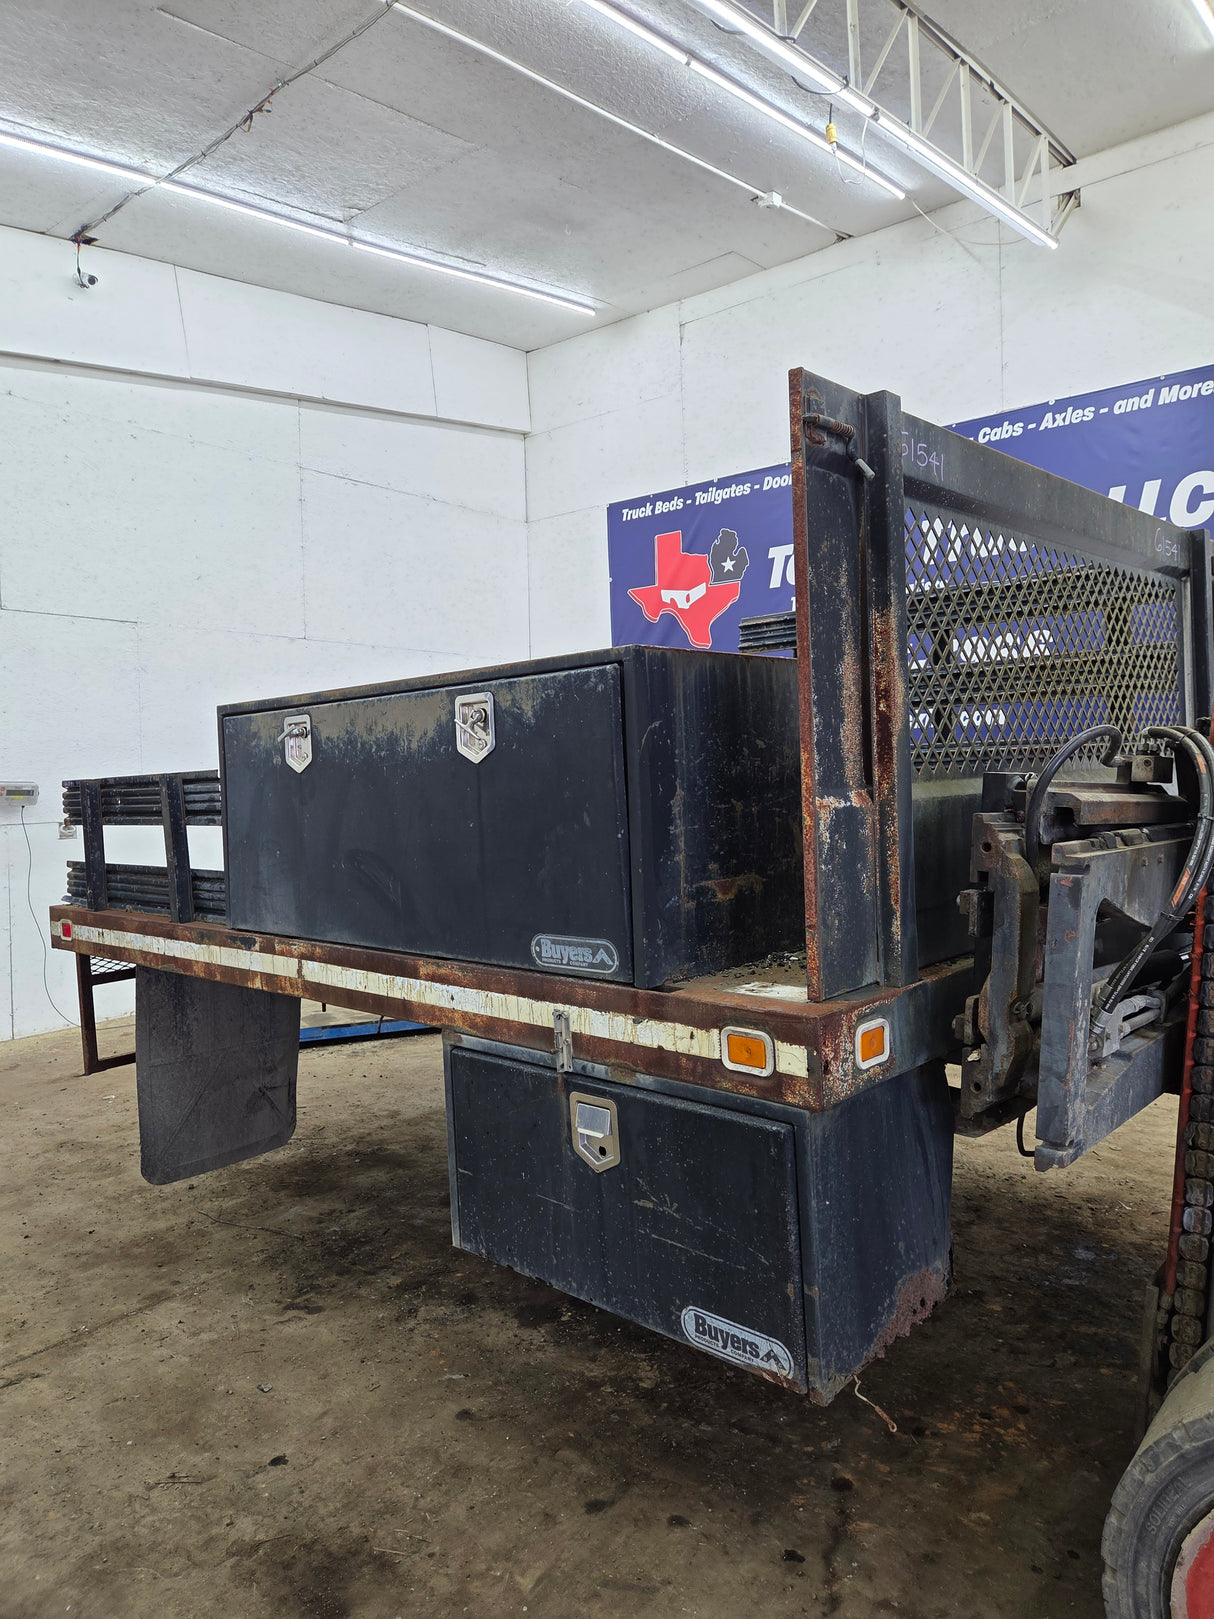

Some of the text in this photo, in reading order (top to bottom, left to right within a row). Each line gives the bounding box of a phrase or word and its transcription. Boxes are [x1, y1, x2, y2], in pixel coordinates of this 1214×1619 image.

[622, 502, 653, 521] Truck
[655, 496, 684, 515] Beds
[694, 482, 751, 505] Tailgates
[978, 421, 1024, 444] Cabs
[1039, 406, 1095, 431] Axles
[1113, 388, 1155, 415] and
[541, 938, 593, 965] Buyers
[693, 1312, 761, 1360] Buyers
